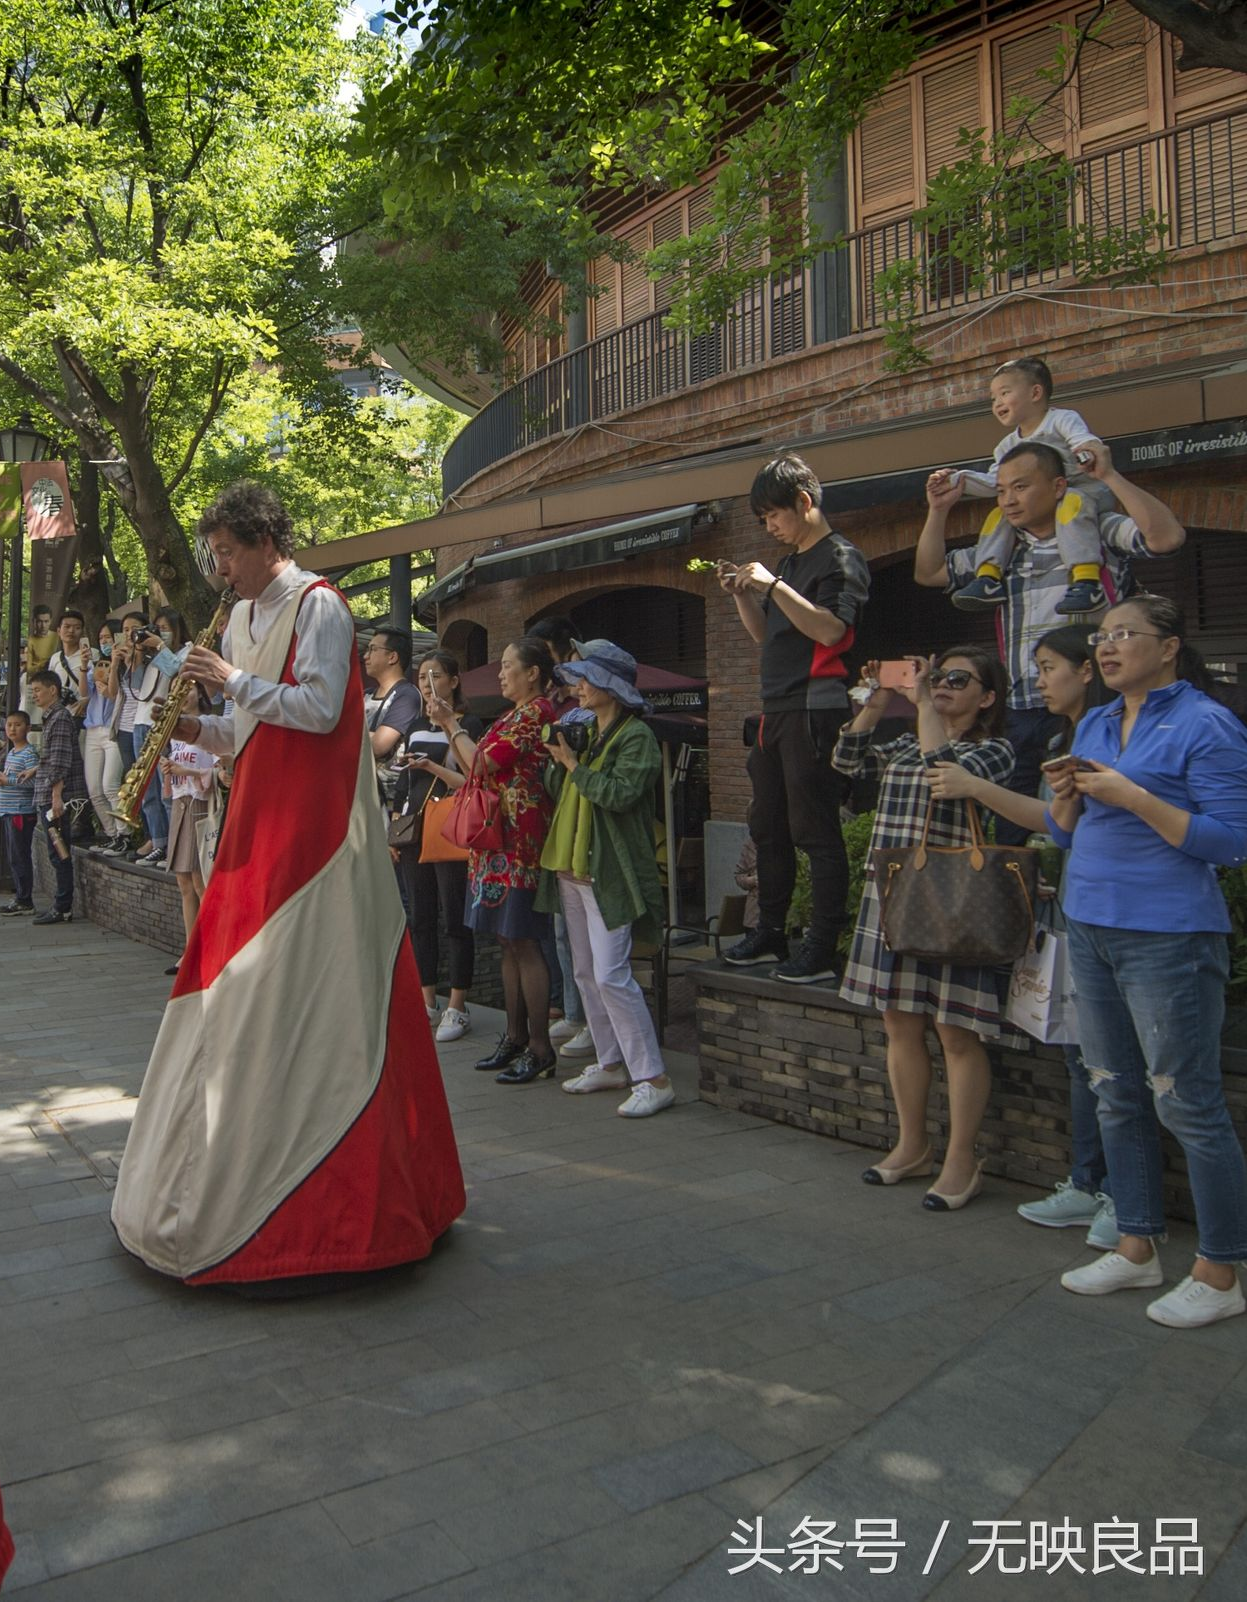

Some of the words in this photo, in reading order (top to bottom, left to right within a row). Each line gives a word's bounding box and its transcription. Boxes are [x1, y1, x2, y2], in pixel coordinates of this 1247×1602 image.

[1132, 444, 1165, 461] HOME
[1168, 441, 1184, 456] OF
[673, 692, 701, 706] COFFEE
